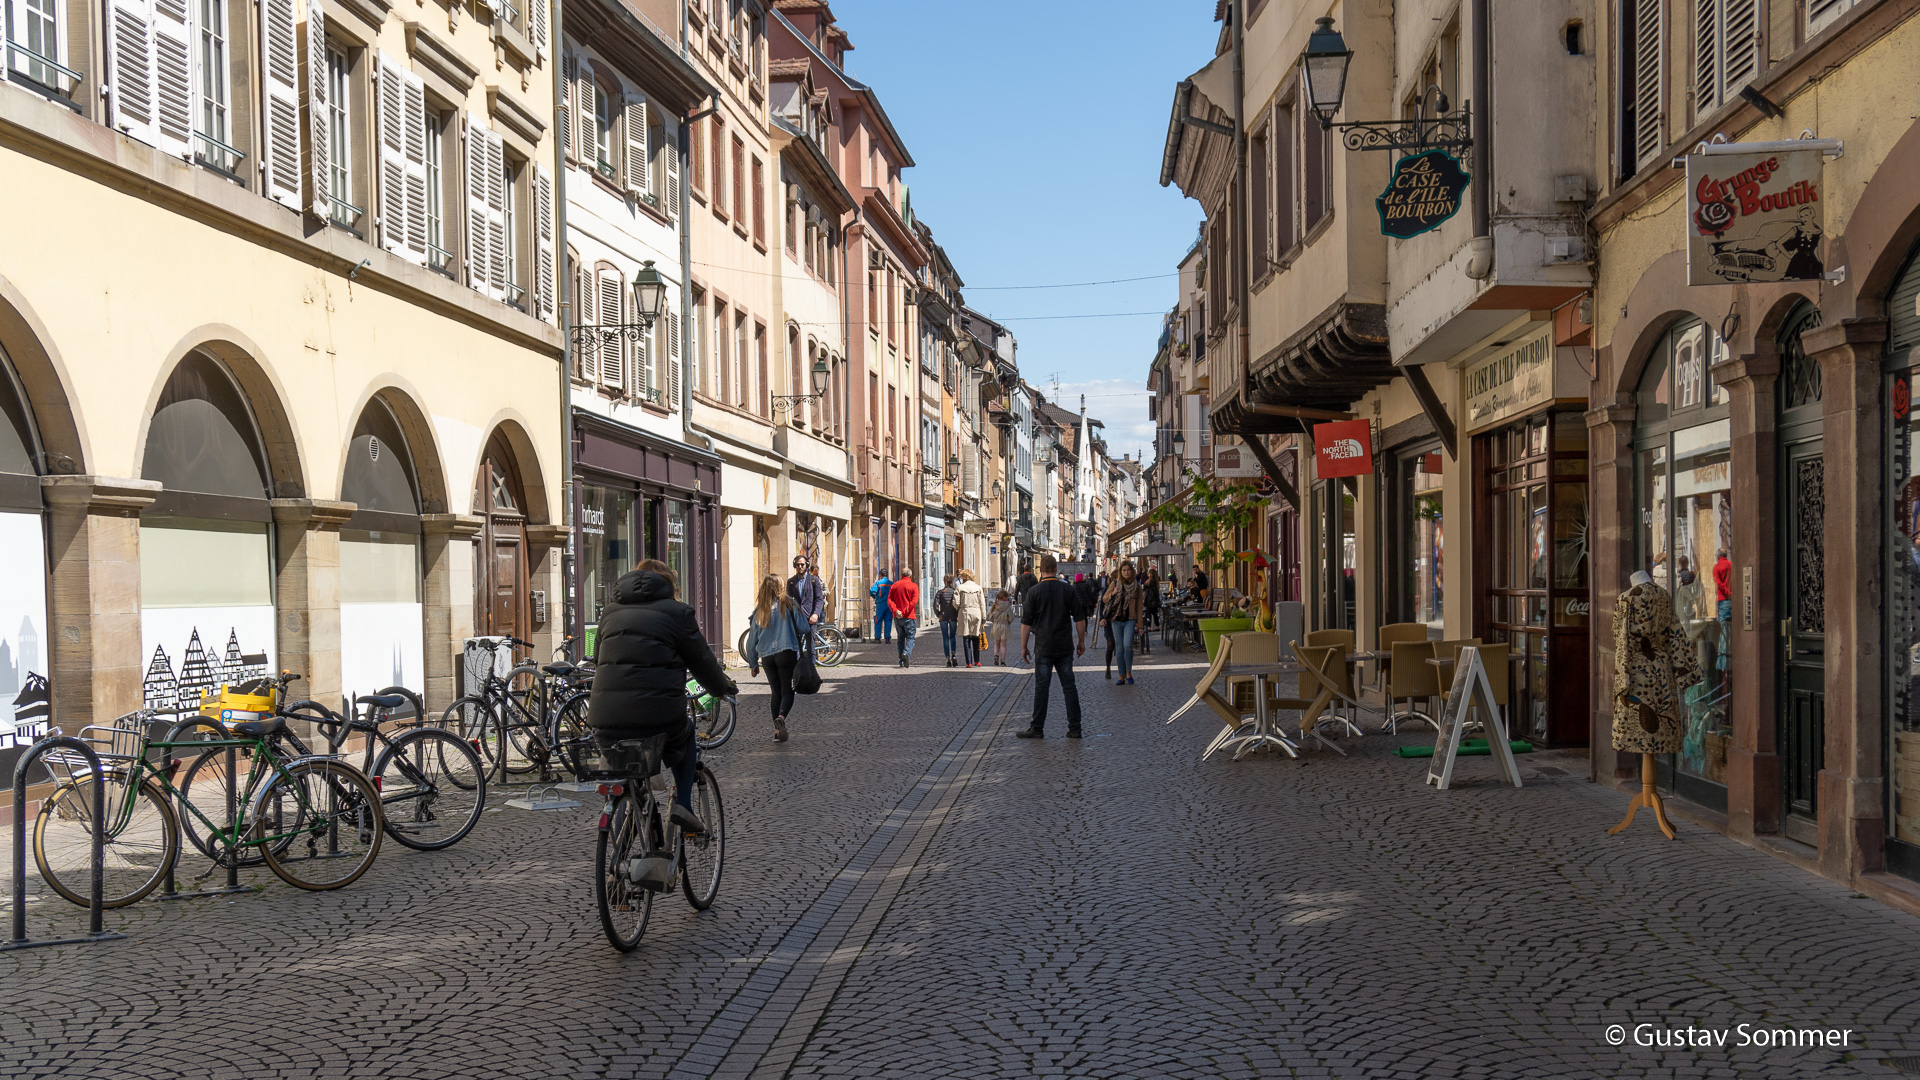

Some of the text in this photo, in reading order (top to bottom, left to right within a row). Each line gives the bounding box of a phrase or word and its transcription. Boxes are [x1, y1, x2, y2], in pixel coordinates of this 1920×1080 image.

[1400, 156, 1435, 174] La
[1395, 173, 1442, 189] CASE
[1696, 156, 1780, 205] Grunge
[1384, 191, 1404, 205] de
[1734, 179, 1819, 217] Boutik
[1386, 200, 1456, 224] BOURBON
[1466, 373, 1473, 401] LA
[1474, 365, 1488, 397] CASE
[1489, 361, 1498, 390] DE
[1516, 333, 1550, 378] BOURBON
[1322, 445, 1349, 455] NORTH
[1333, 438, 1349, 447] THE
[1330, 451, 1350, 460] FACE
